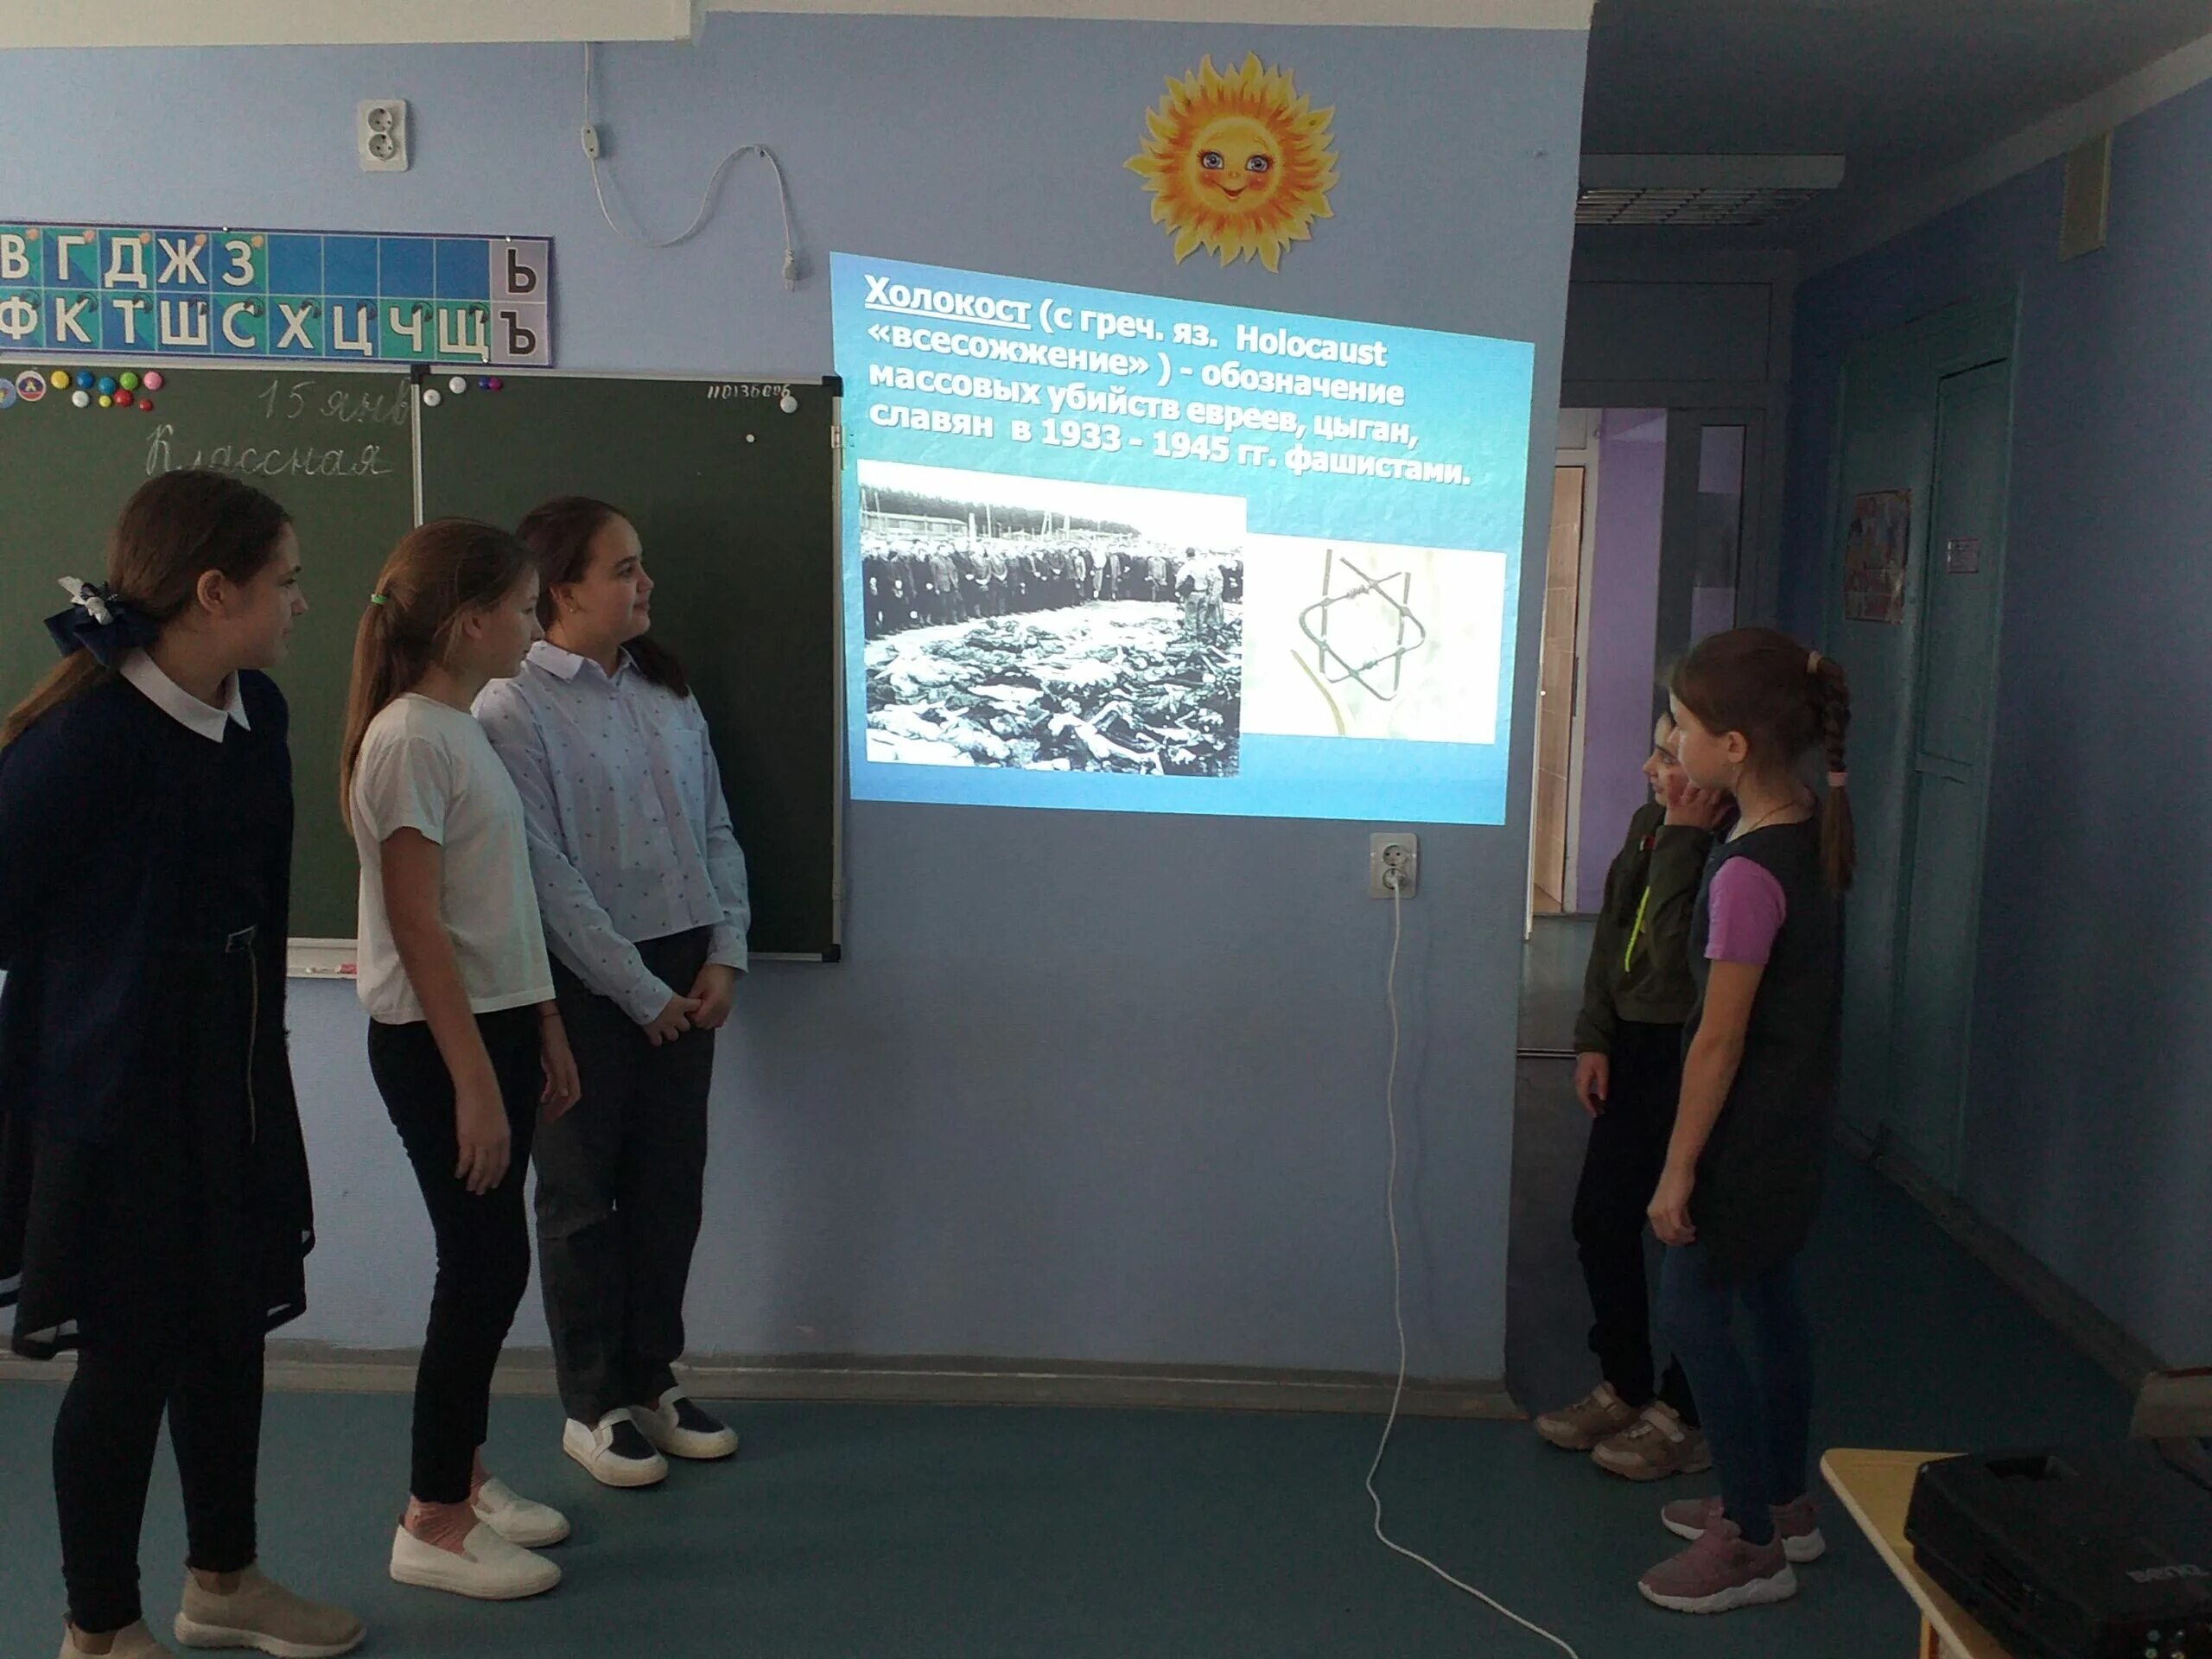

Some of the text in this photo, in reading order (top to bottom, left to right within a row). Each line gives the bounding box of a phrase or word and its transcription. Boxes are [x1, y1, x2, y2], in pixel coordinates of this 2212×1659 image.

[0, 234, 537, 295] В Г Д Ж З Ь
[0, 296, 537, 362] Ф К Т Ш С Х Ц Ч Щ Ъ
[864, 274, 1388, 368] Холокост (с греч. яз. Holocaust
[258, 378, 317, 420] 15
[868, 364, 1419, 448] массовых убийств евреев, цыган,
[1201, 362, 1405, 407] обозначение
[869, 403, 993, 440] славян
[1011, 421, 1032, 442] в
[1042, 417, 1122, 453] 1933
[1154, 431, 1230, 463] 1945
[1236, 444, 1276, 468] гг.
[1285, 444, 1472, 486] фашистами.
